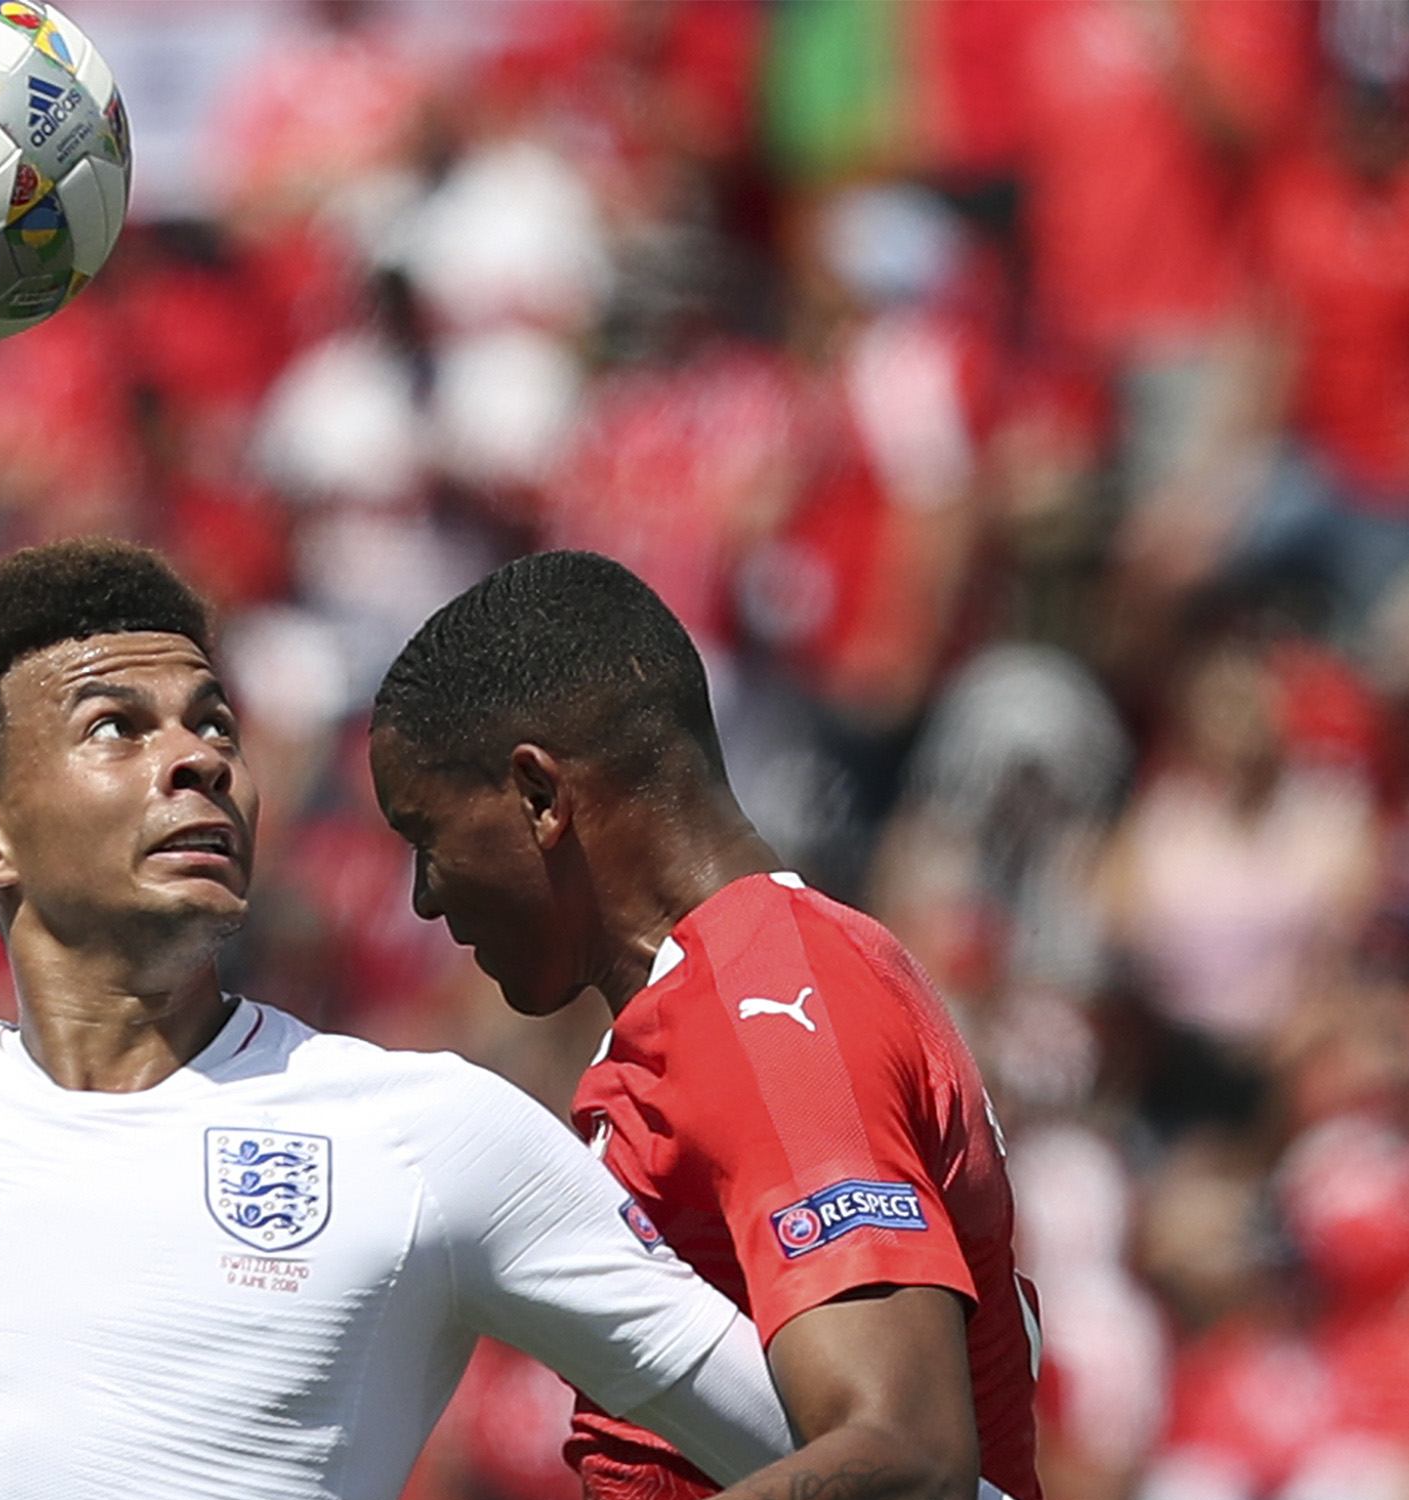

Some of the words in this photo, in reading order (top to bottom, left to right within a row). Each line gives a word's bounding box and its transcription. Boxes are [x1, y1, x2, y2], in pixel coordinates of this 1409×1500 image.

[30, 89, 81, 147] adidas
[820, 1191, 920, 1227] RESPECT
[220, 1255, 309, 1279] SWITZERLAND
[227, 1272, 236, 1284] 9
[240, 1274, 267, 1289] JUNE
